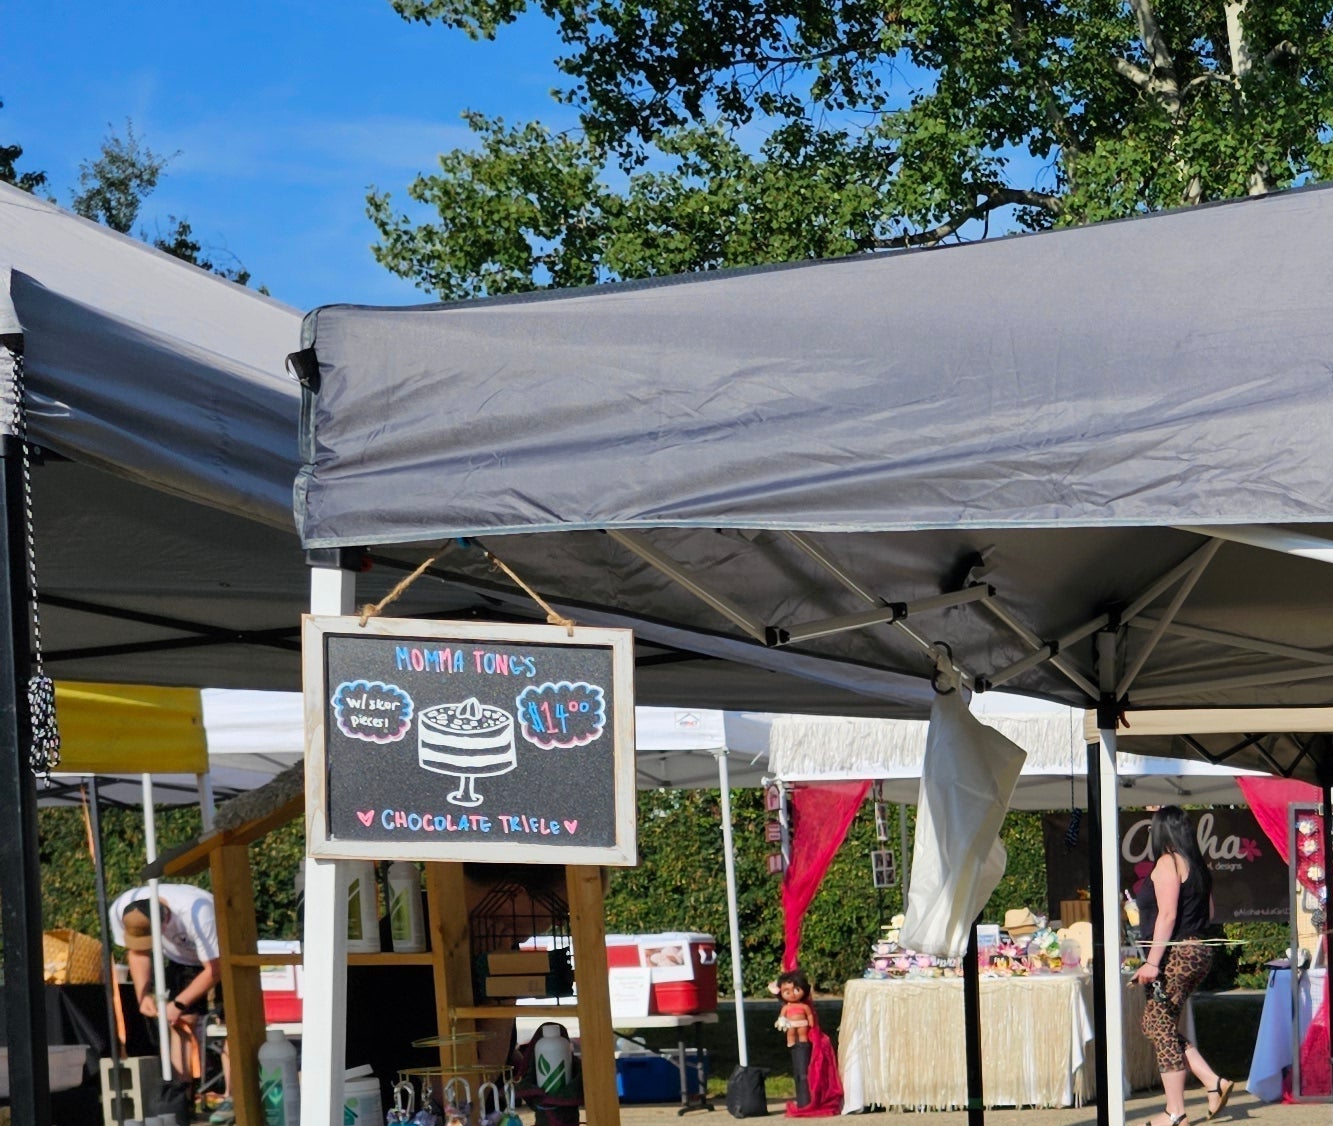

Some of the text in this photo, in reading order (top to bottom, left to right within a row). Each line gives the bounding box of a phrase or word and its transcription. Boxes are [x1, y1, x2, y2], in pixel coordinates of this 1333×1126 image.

[395, 646, 464, 673] MOMMA
[381, 809, 561, 835] CHOCOLATE TRIFLE
